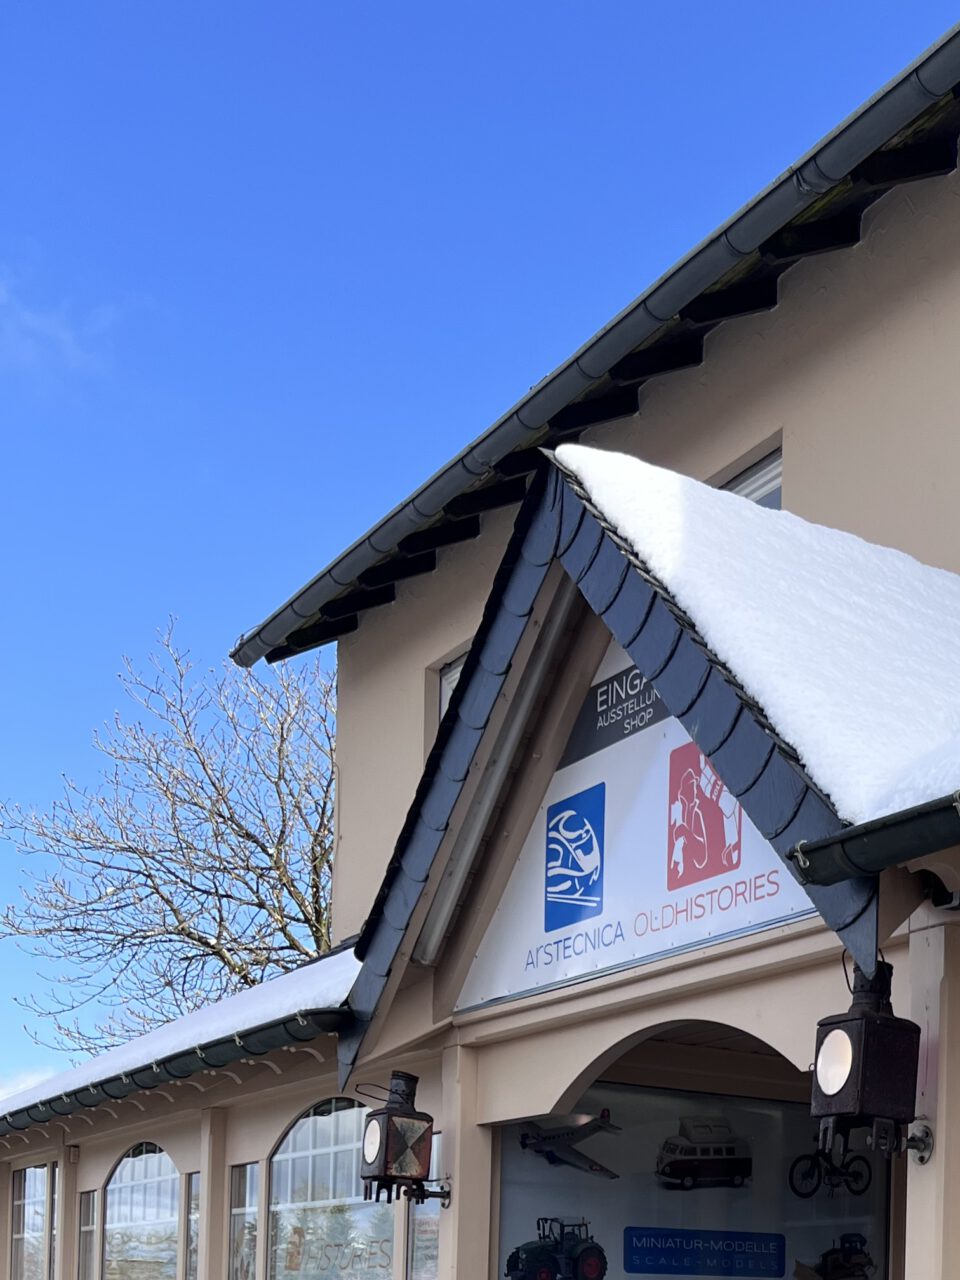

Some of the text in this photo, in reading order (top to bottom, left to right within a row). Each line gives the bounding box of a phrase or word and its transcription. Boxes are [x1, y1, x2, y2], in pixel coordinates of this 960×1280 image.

[623, 708, 653, 734] SHOP
[633, 869, 780, 937] OLDHISTORIES
[632, 1236, 777, 1253] MINIATUR-MODELLE
